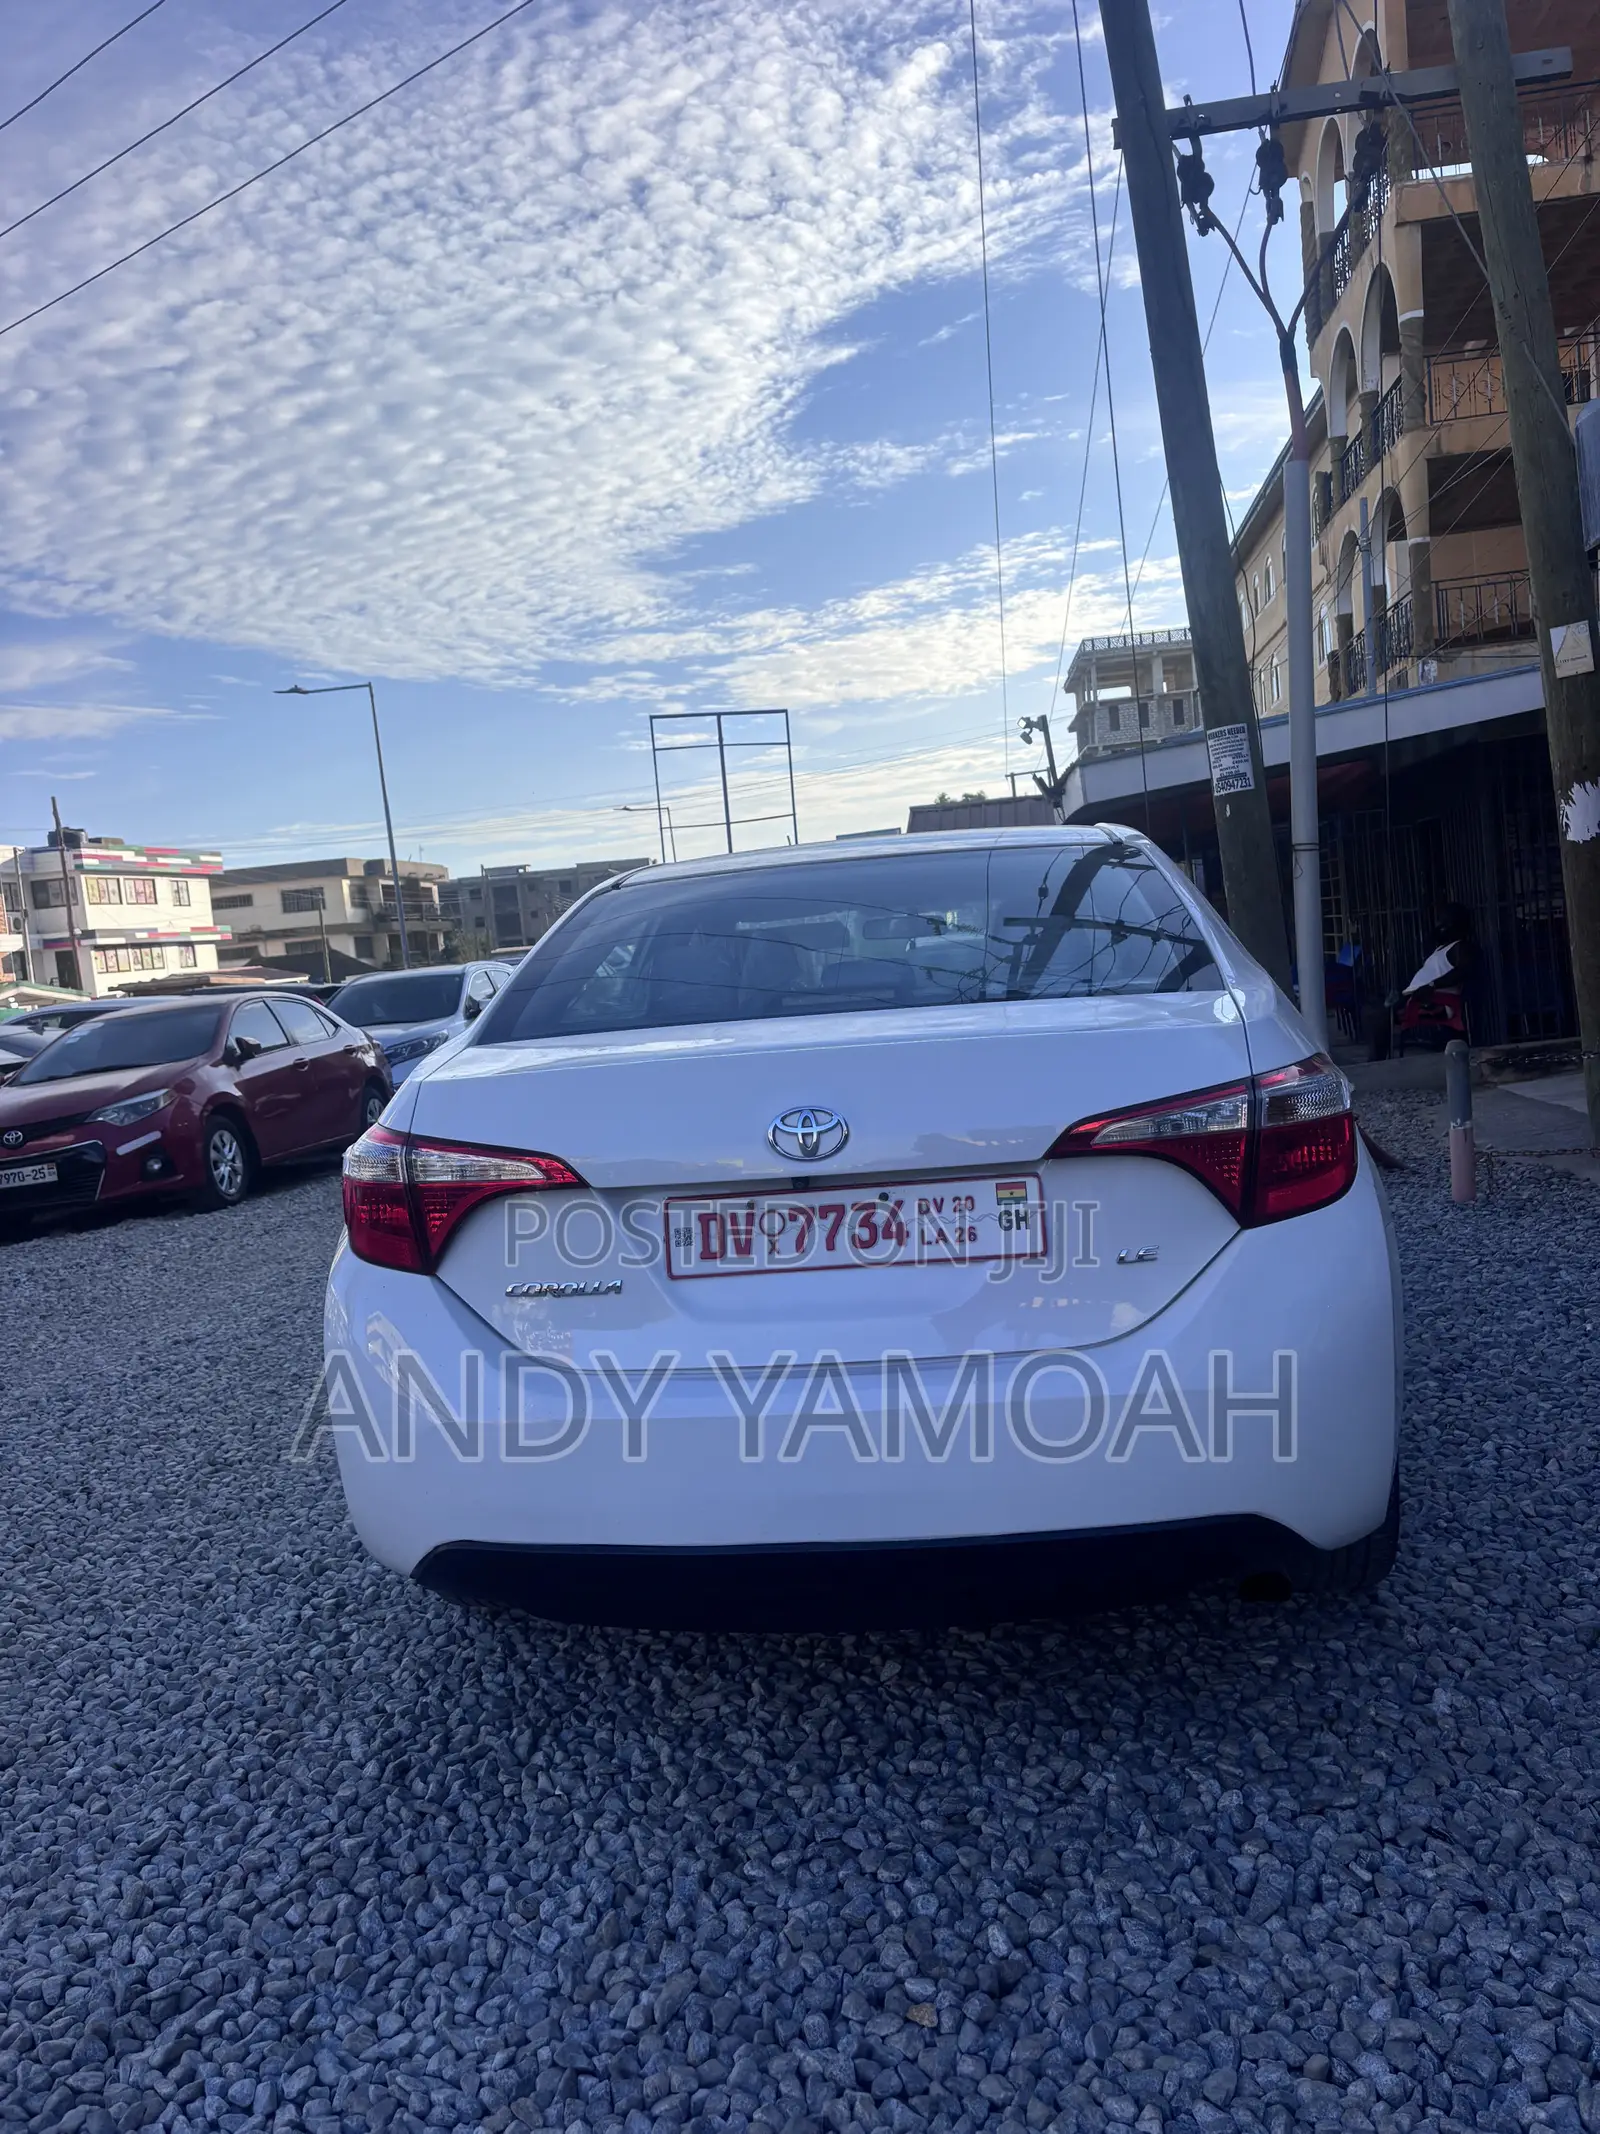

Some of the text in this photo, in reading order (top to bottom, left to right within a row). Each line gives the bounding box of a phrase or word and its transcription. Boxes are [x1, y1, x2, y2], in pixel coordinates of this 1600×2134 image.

[919, 1197, 944, 1214] DV
[698, 1200, 910, 1260] DV 7734
[998, 1209, 1030, 1231] GH
[1116, 1245, 1160, 1265] LE
[505, 1279, 623, 1298] COROLLA
